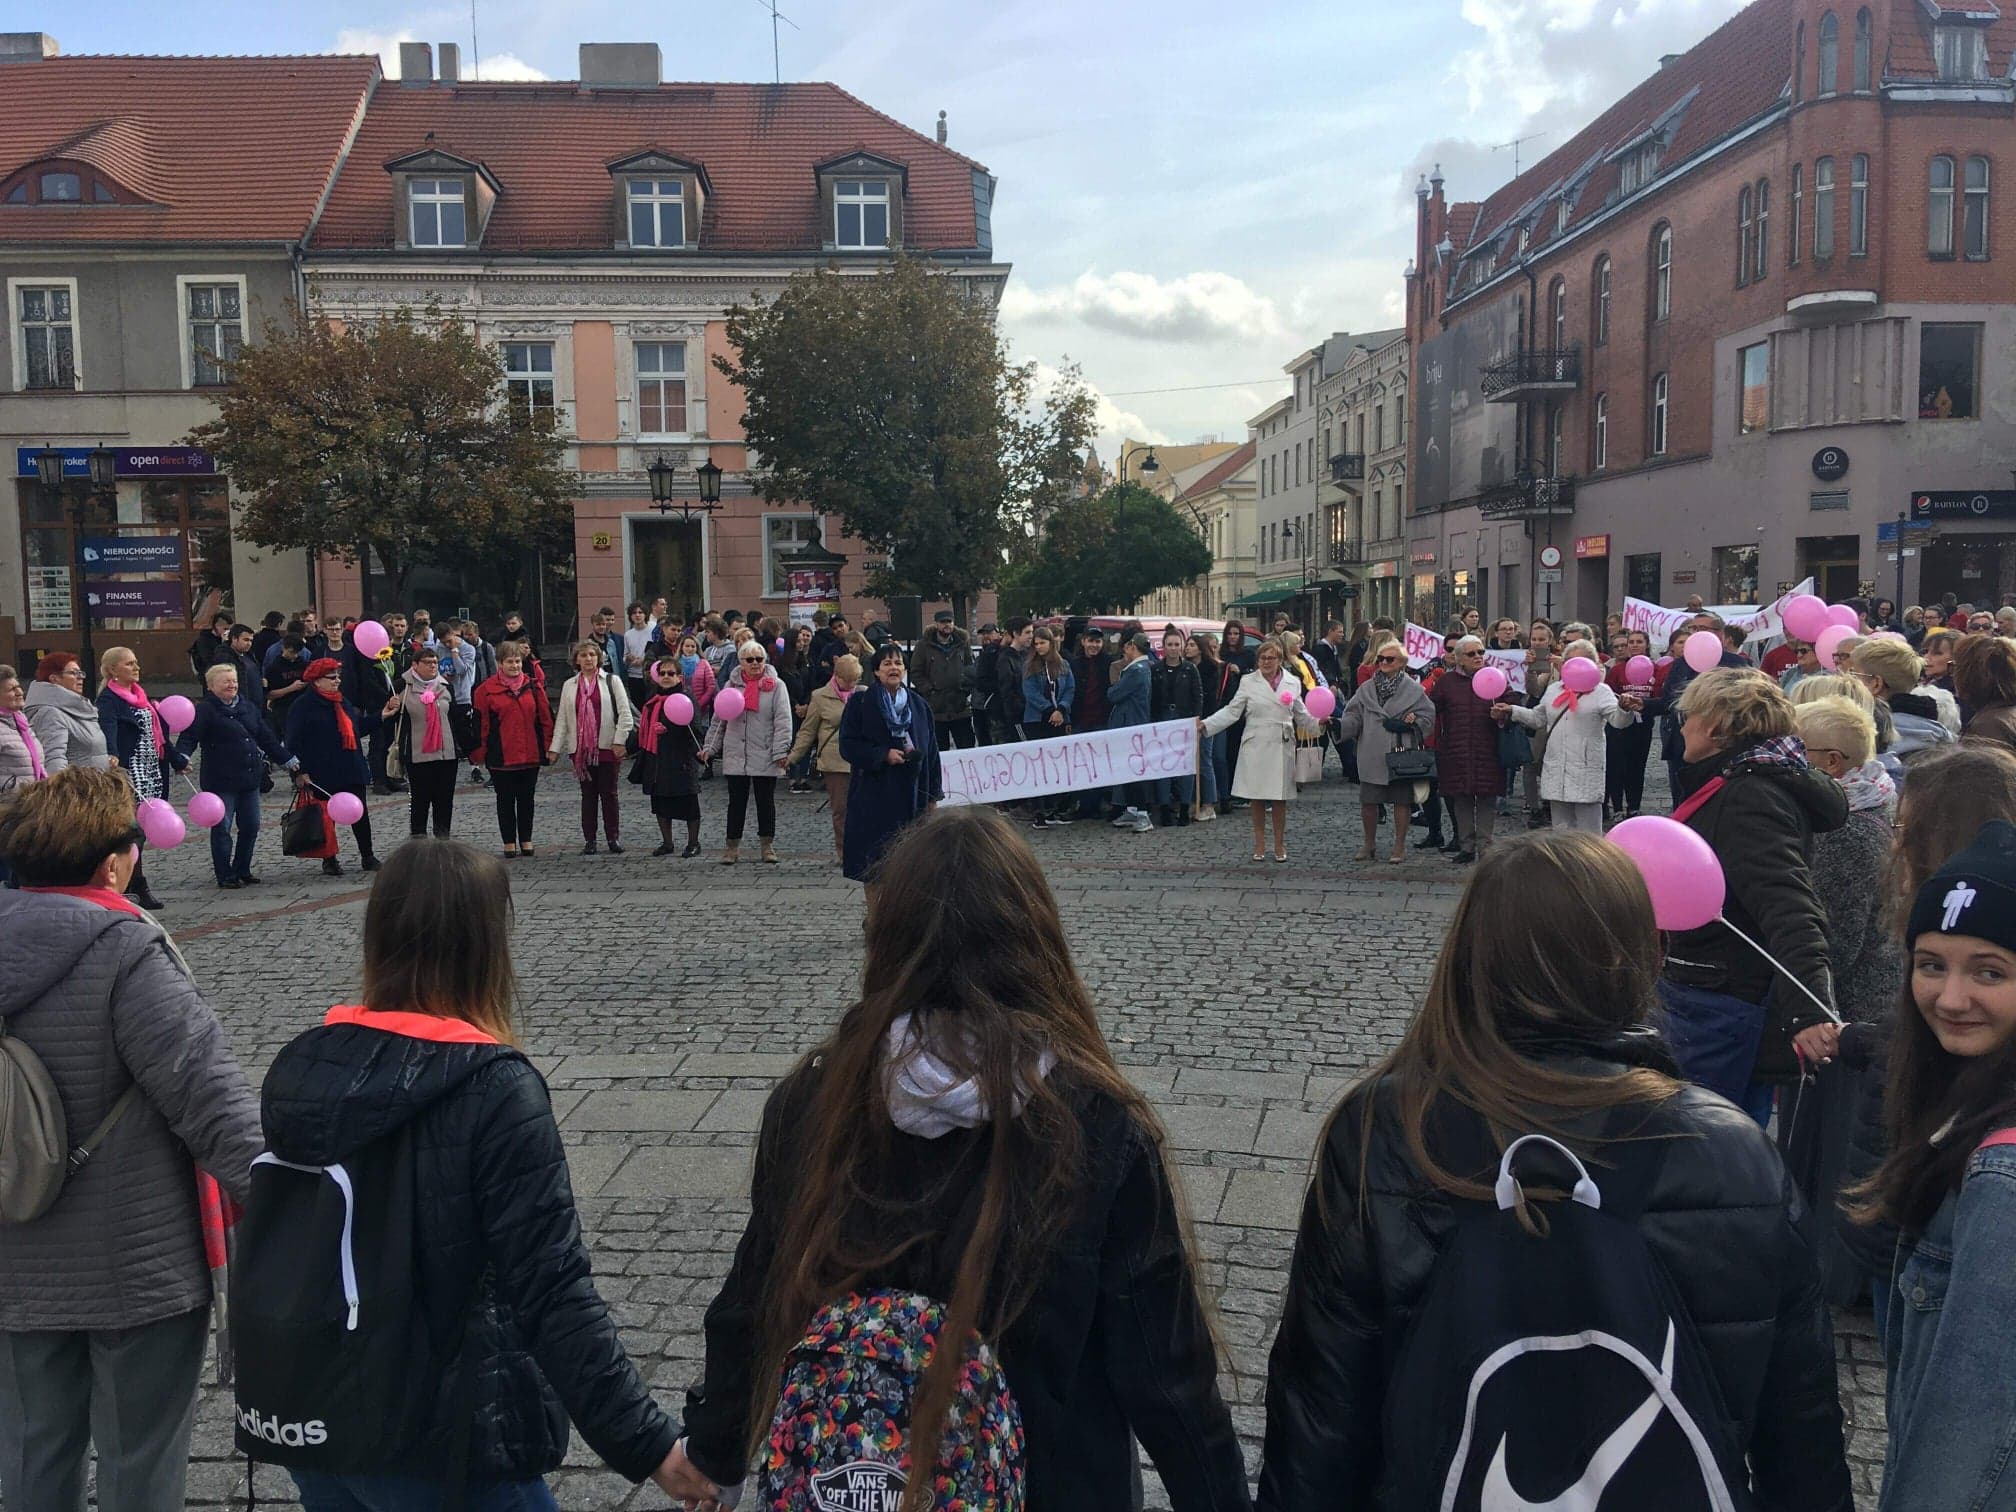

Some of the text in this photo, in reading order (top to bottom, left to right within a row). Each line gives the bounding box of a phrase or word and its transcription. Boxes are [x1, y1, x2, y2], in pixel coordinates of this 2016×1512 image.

[130, 455, 185, 468] open direct
[595, 537, 608, 545] 20
[103, 546, 175, 555] NIERUCHOMOŚCI
[105, 592, 143, 600] FINANSE
[847, 1471, 888, 1489] VANS
[850, 1490, 879, 1512] THE
